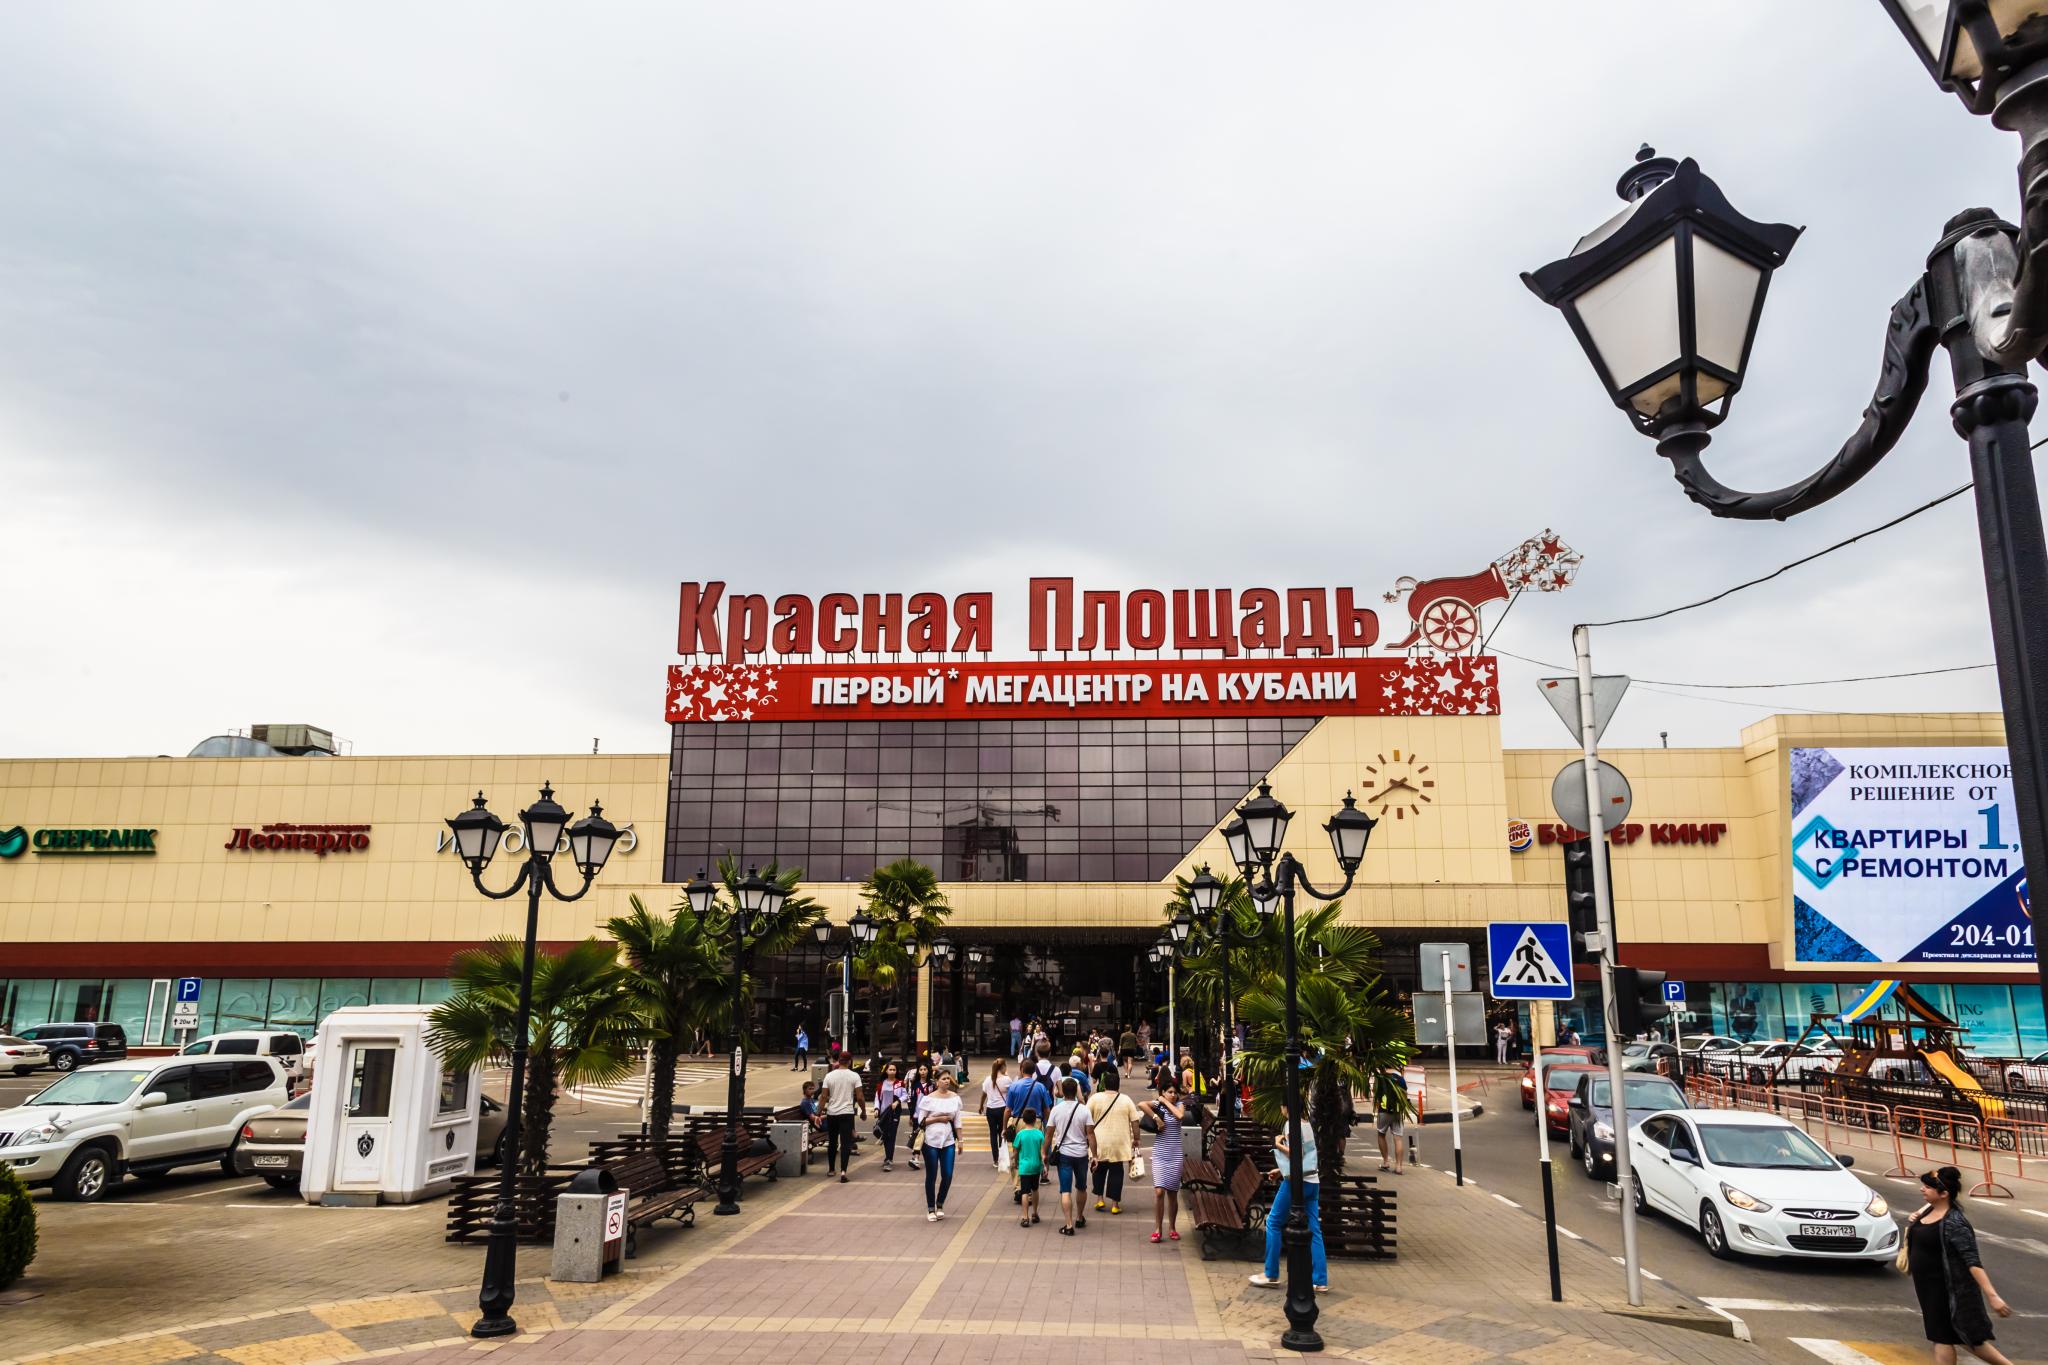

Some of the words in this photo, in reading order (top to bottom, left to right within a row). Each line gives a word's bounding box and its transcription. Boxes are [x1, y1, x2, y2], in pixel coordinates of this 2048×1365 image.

[677, 581, 993, 664] Красная
[1029, 576, 1380, 657] Площадь
[965, 674, 1153, 707] МЕГАЦЕНТР
[1161, 673, 1211, 702] НА
[1217, 671, 1358, 701] КУБАНИ
[1850, 787, 1955, 801] РЕШЕНИЕ
[1968, 786, 1997, 801] ОТ
[32, 829, 158, 849] СБЕРБАНК
[224, 828, 370, 857] Леонардо
[1538, 823, 1644, 845] БУЕР
[1650, 823, 1727, 845] КИНГ
[1815, 829, 1968, 849] КВАРТИРЫ
[1815, 857, 1832, 879] С
[1842, 858, 2008, 878] РЕМОНТОМ
